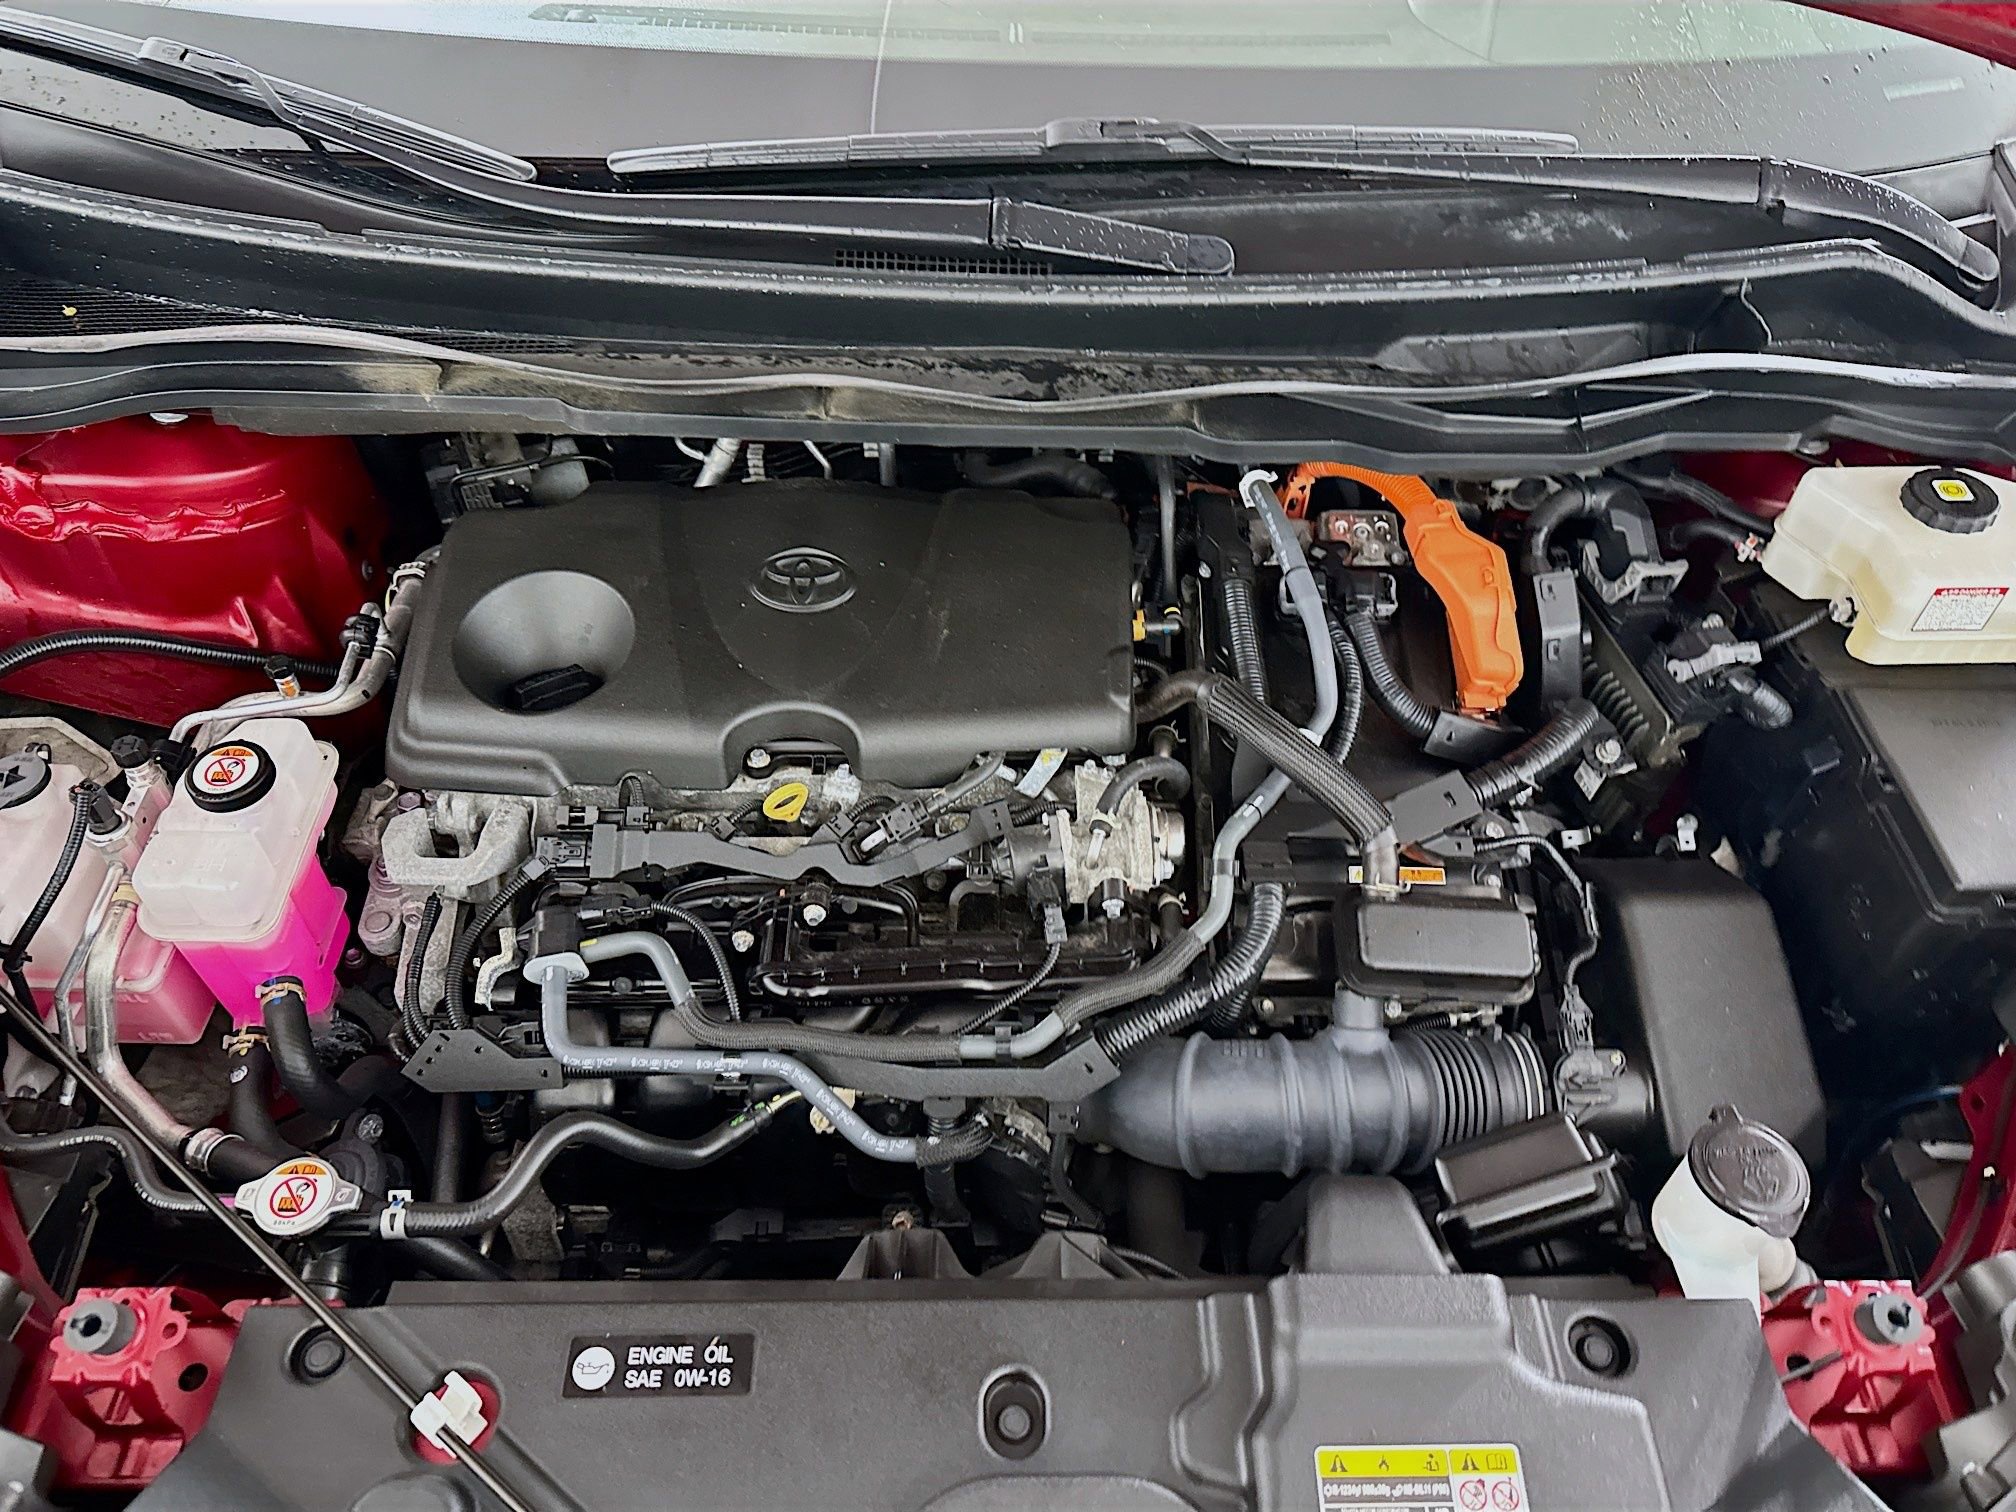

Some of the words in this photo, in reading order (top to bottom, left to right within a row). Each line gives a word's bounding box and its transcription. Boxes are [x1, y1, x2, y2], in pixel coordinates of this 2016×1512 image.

[627, 1345, 695, 1365] ENGINE
[703, 1344, 734, 1364] OIL
[624, 1369, 664, 1388] SAE
[673, 1368, 732, 1388] 0W-16
